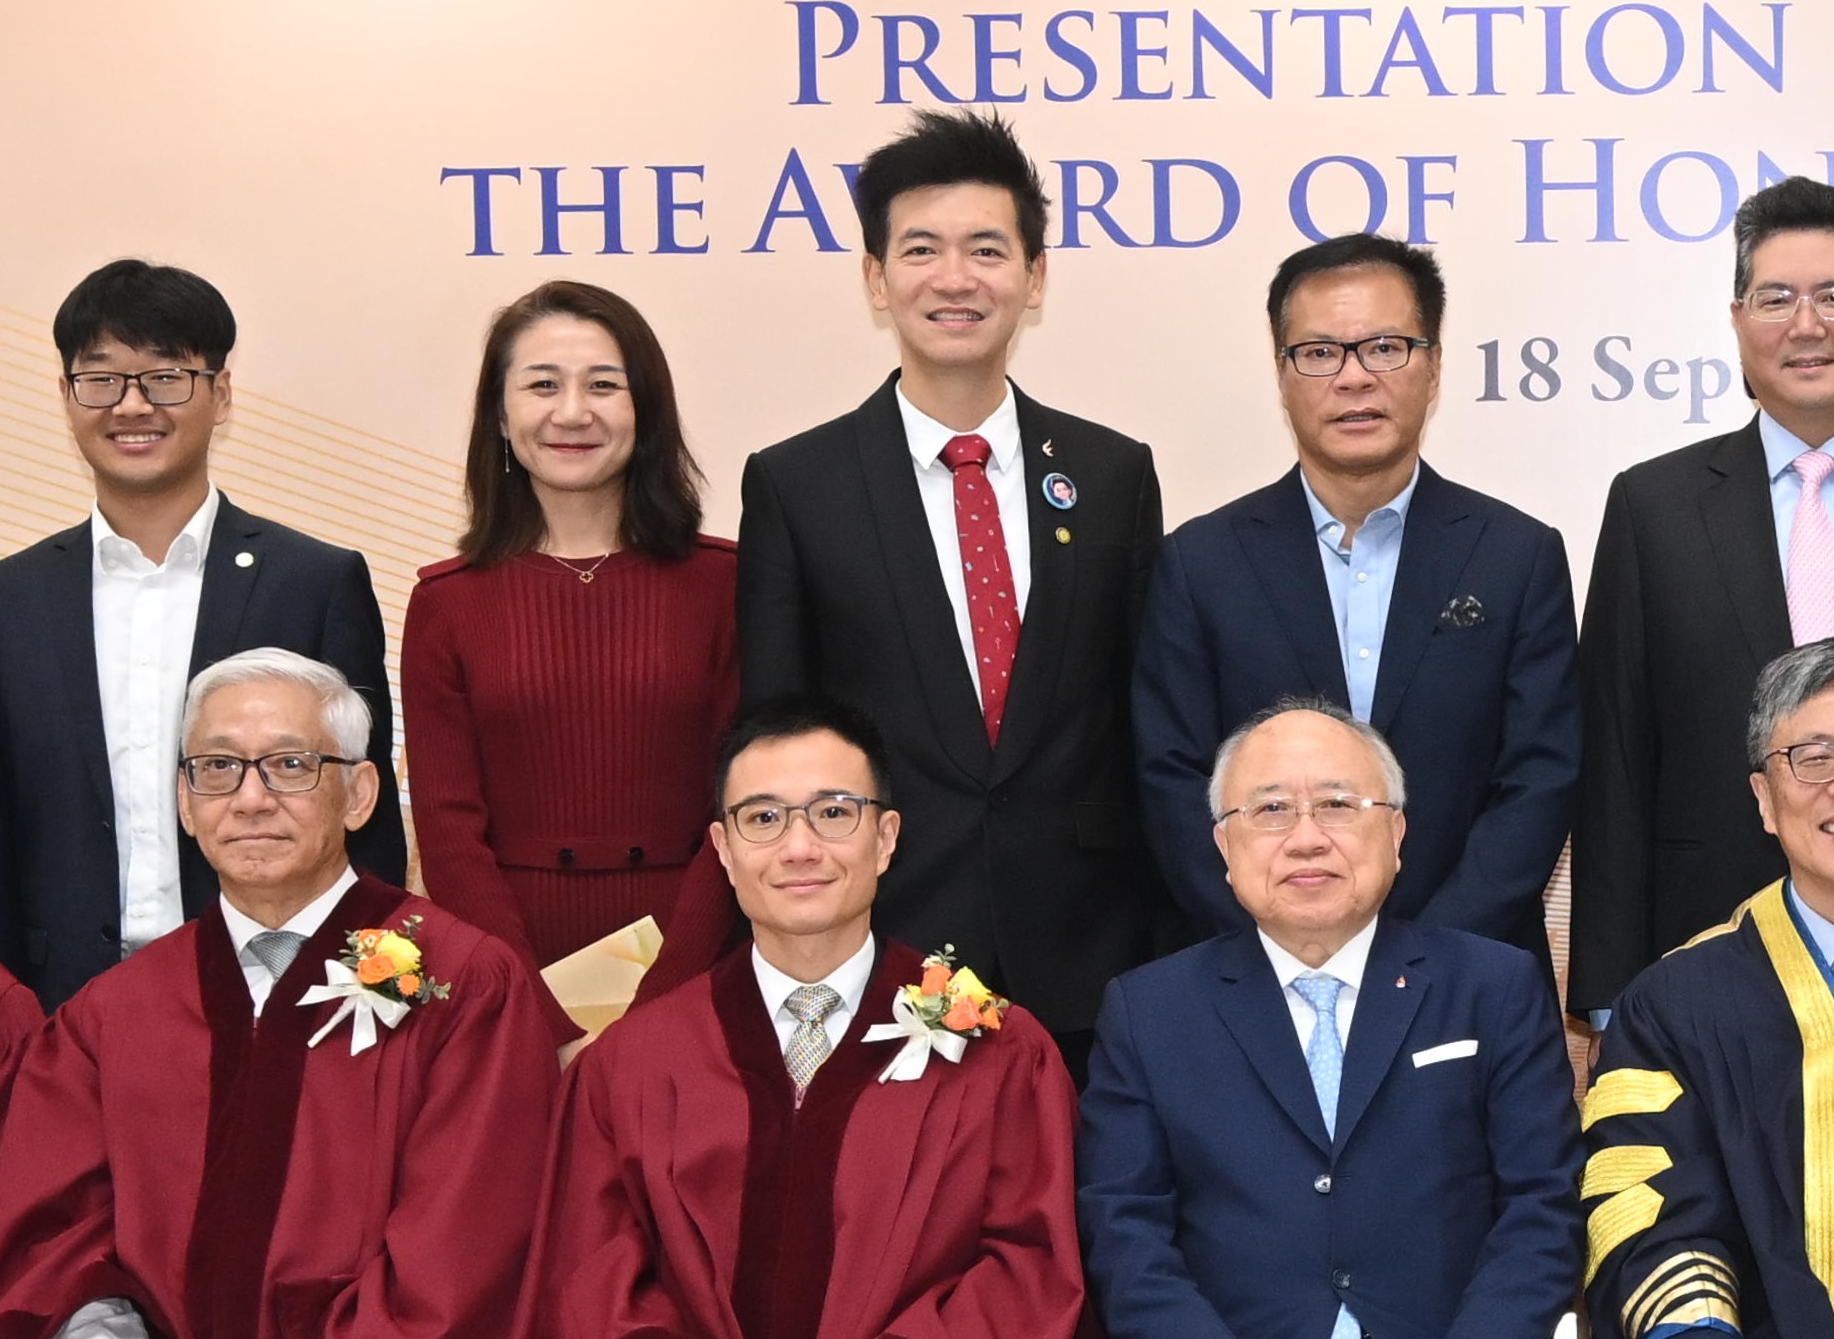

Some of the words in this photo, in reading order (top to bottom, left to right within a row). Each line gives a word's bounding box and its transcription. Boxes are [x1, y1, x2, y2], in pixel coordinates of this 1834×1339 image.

[784, 0, 1792, 106] PRESENTATION
[440, 164, 712, 258] THE
[741, 146, 1243, 254] ARD
[1287, 154, 1459, 245] OF
[1475, 336, 1562, 402] 18
